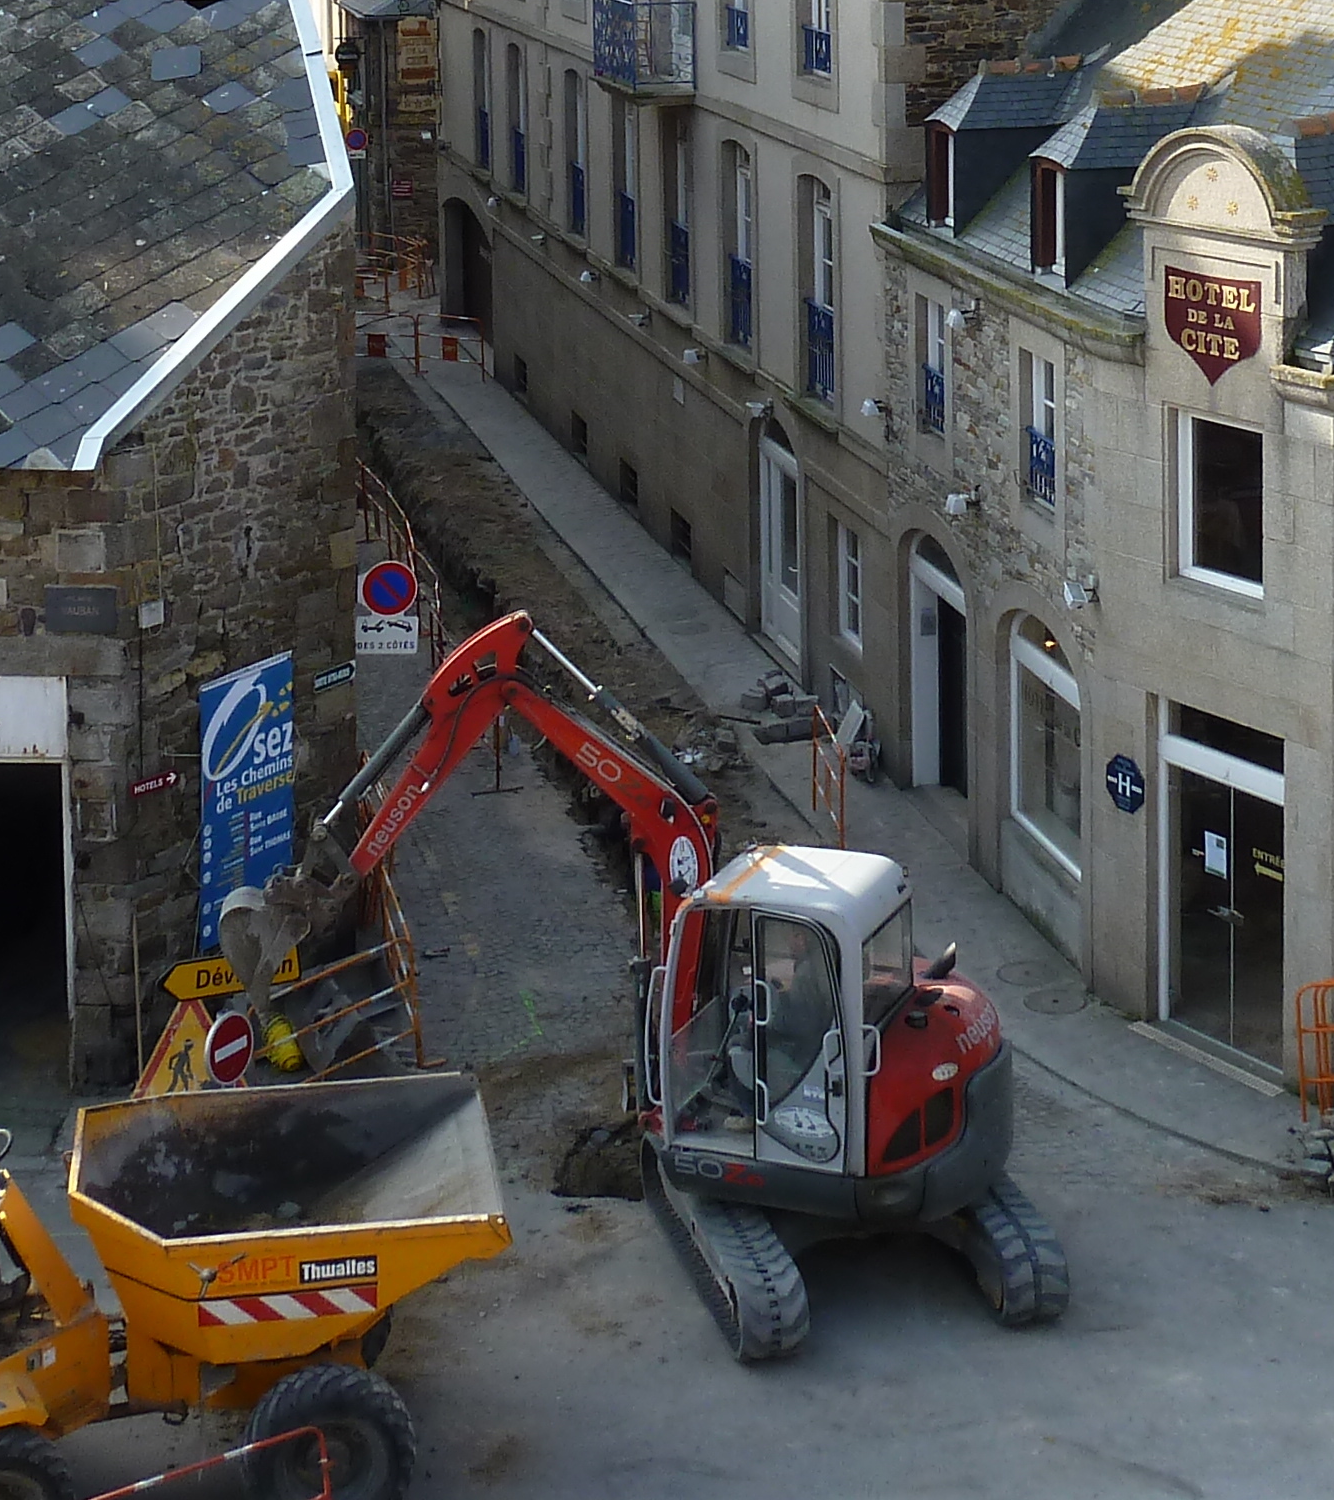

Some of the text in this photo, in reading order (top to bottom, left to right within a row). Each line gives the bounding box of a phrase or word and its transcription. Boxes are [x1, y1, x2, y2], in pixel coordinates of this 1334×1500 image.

[1168, 276, 1256, 313] HOTEL
[1187, 308, 1235, 331] DE LA
[1181, 328, 1240, 361] CITE
[357, 642, 375, 650] DES
[386, 640, 415, 650] CÔTÉS
[134, 778, 163, 795] HOTELS
[217, 755, 293, 797] Les Chemins
[1118, 772, 1130, 797] H
[217, 796, 232, 814] de
[366, 784, 423, 857] neuson
[218, 1255, 375, 1285] SMPT Thwaites
